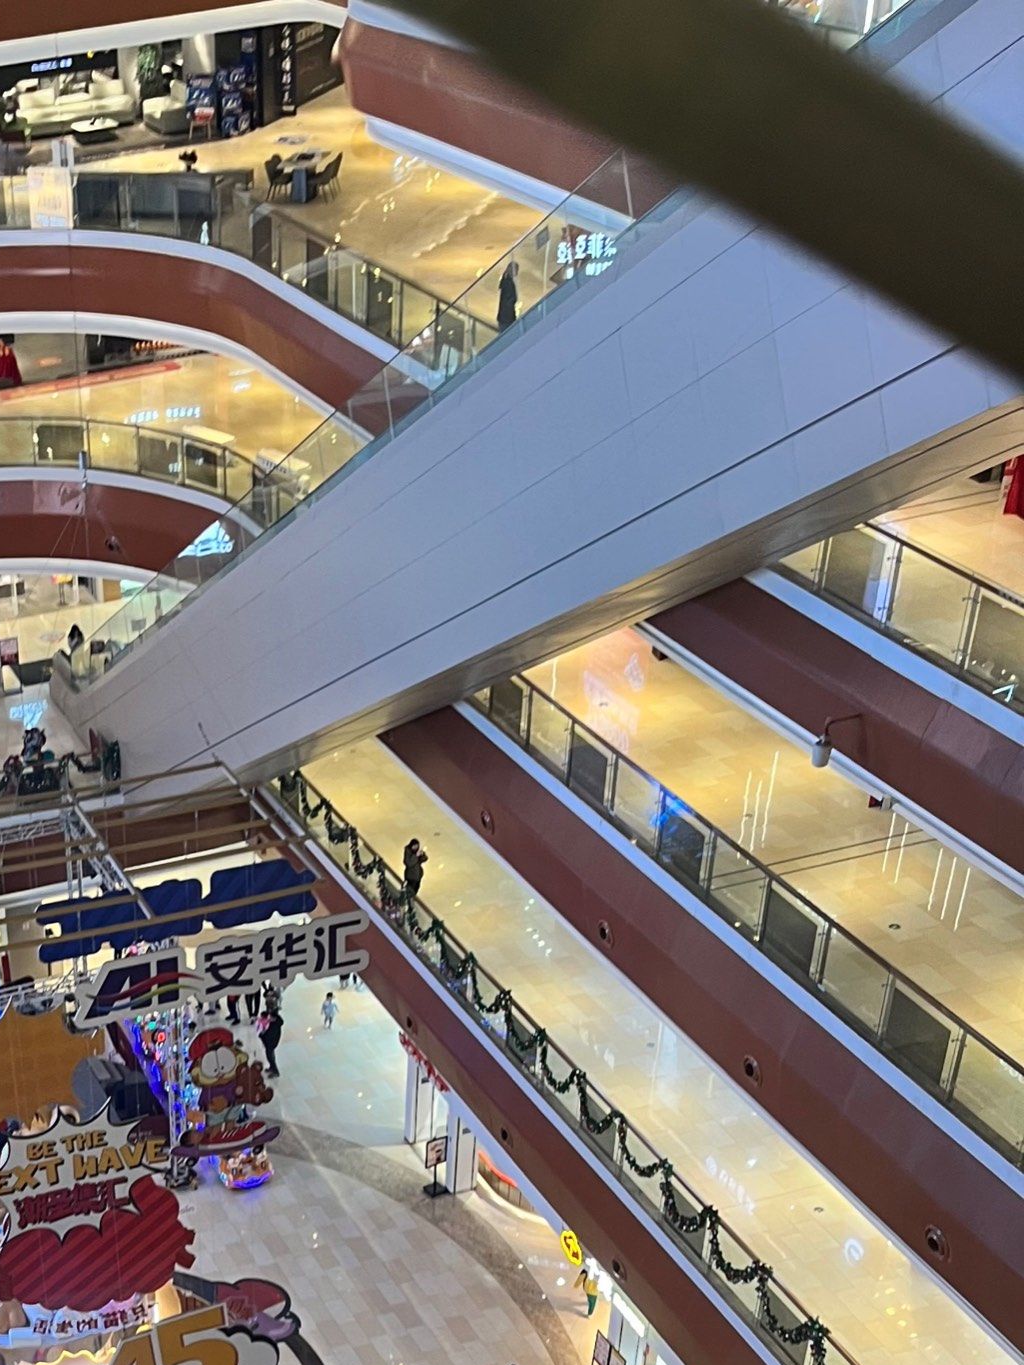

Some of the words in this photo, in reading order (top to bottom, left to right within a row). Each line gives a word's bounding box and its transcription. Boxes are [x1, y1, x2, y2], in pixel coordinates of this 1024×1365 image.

[204, 919, 362, 995] 安华汇
[26, 1141, 58, 1161] BE
[62, 1130, 108, 1152] THE
[72, 1138, 170, 1181] WAVE
